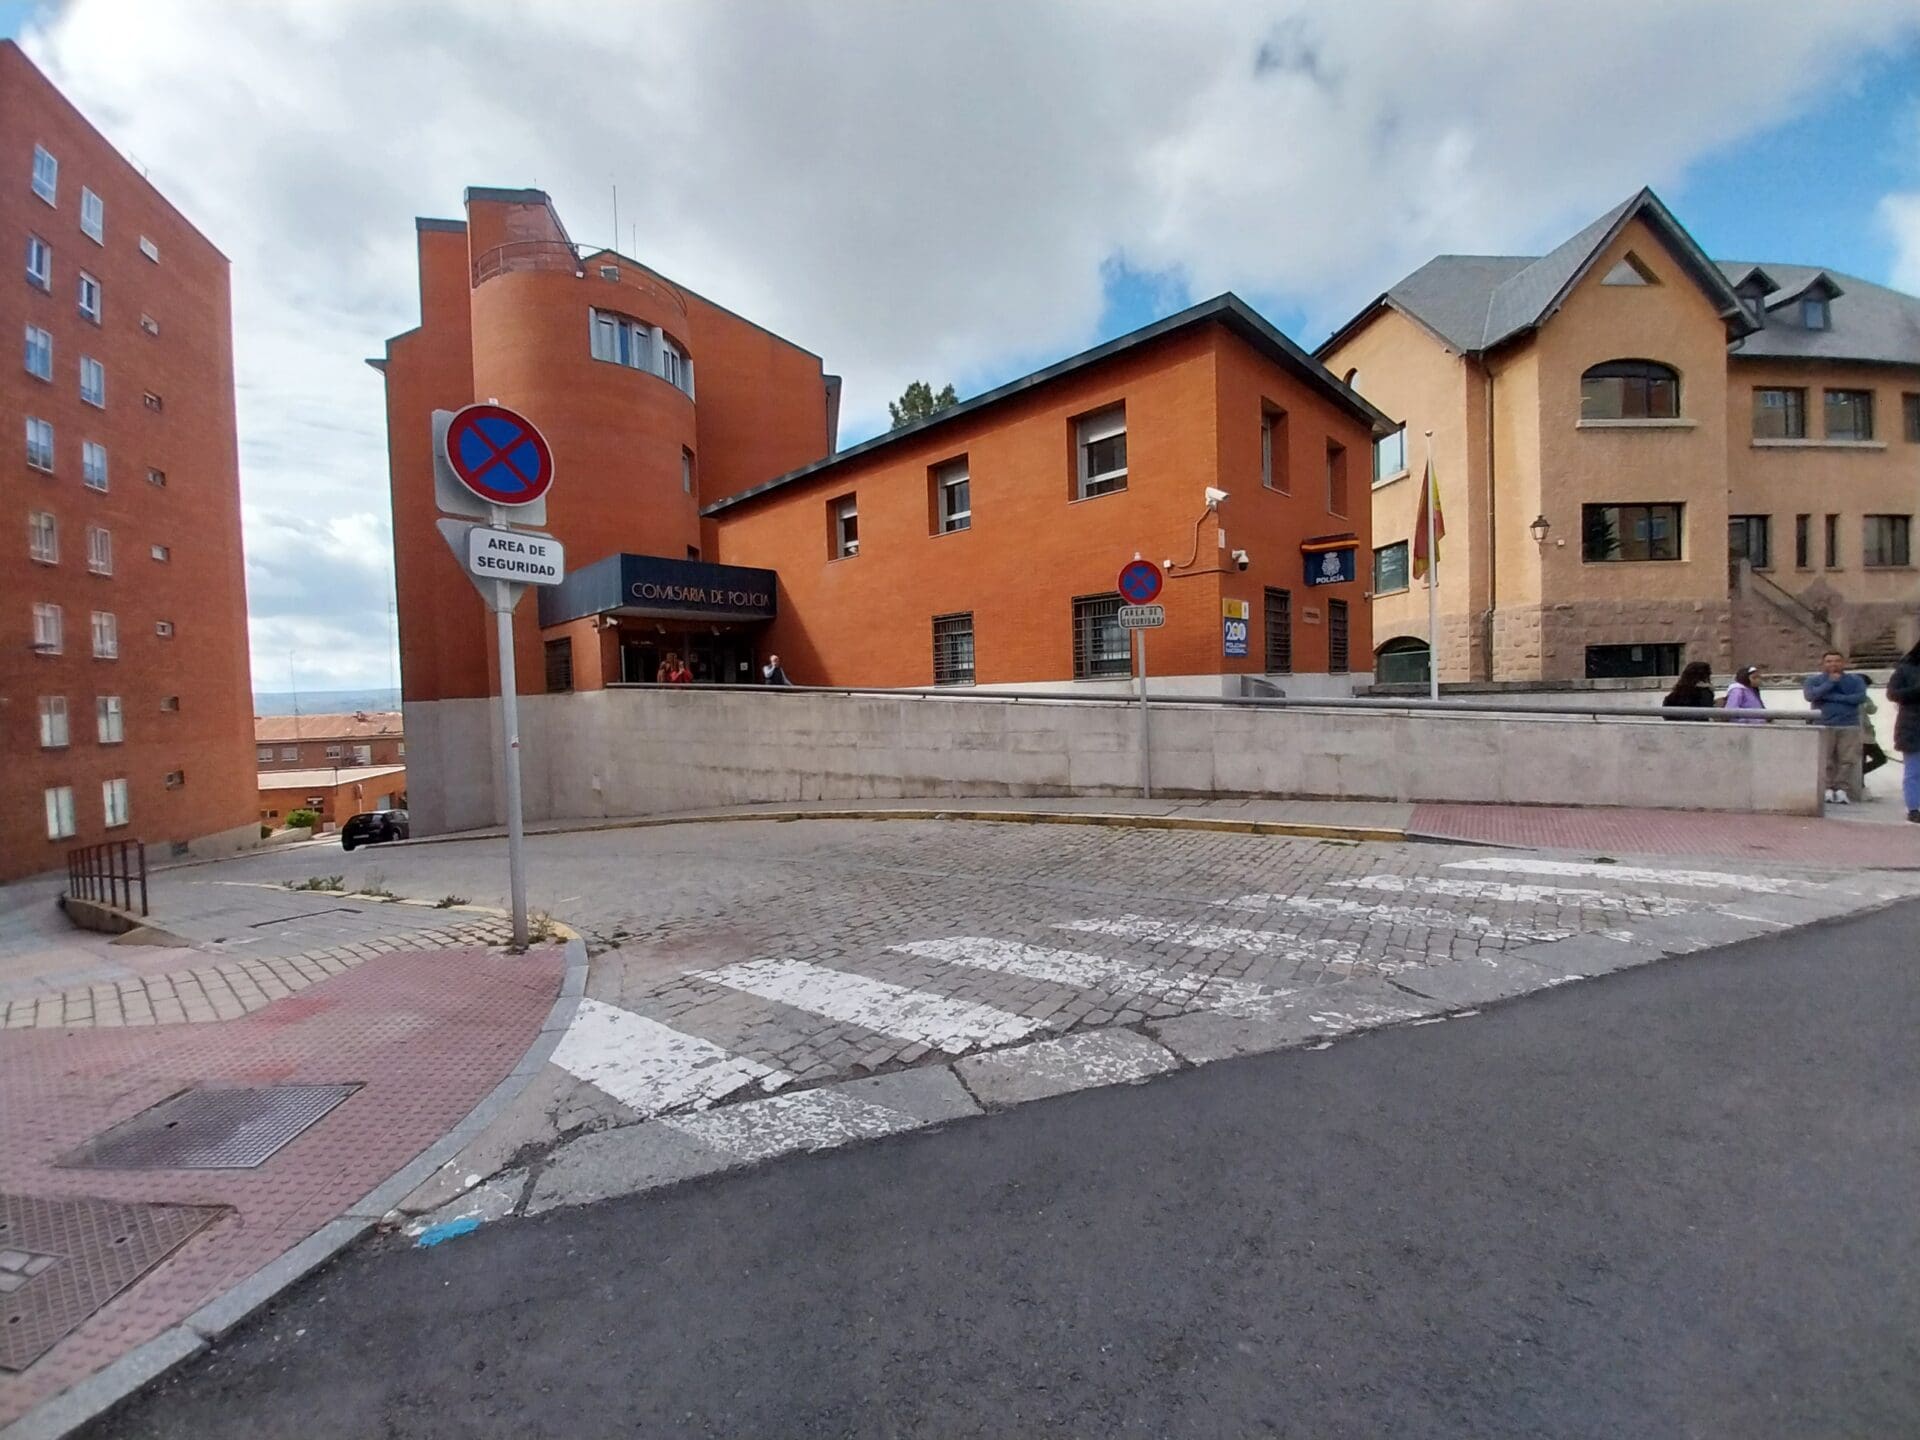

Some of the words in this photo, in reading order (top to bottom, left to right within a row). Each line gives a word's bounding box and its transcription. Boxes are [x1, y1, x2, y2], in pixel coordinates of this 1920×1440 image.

[488, 538, 525, 554] AREA
[529, 544, 546, 557] DE
[477, 556, 556, 577] SEGURIDAD
[631, 582, 706, 603] COMISARIA
[711, 589, 724, 604] DE
[1124, 609, 1145, 617] AREA
